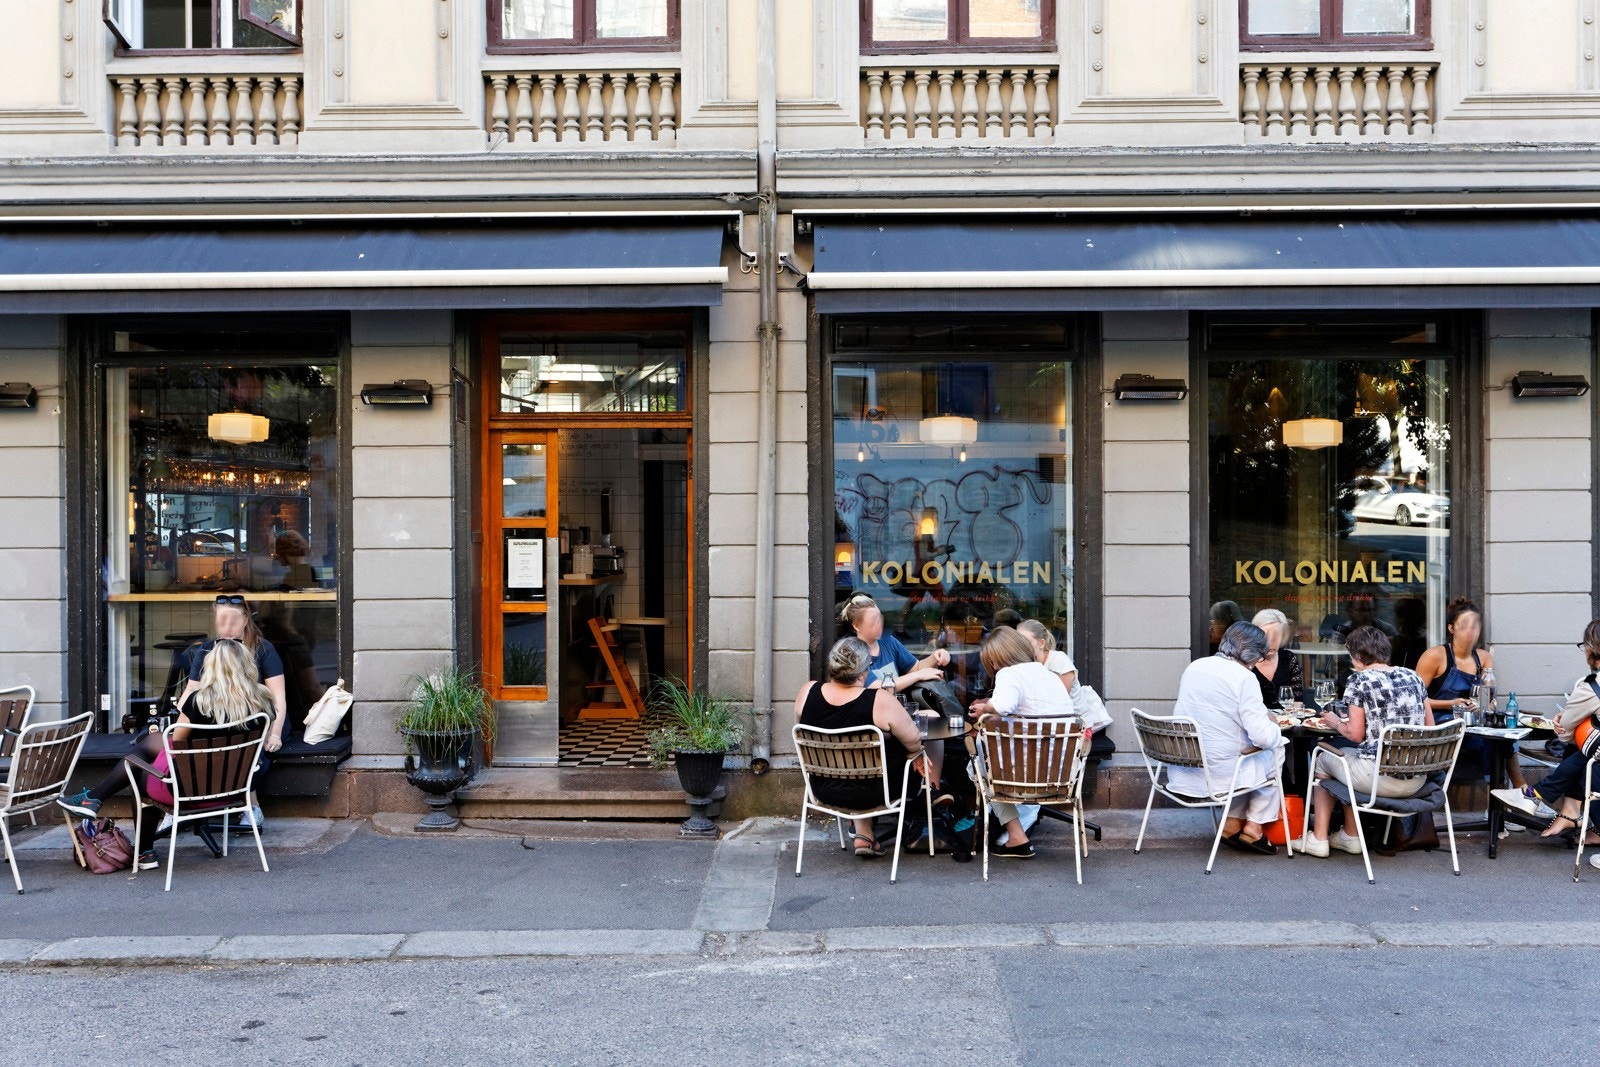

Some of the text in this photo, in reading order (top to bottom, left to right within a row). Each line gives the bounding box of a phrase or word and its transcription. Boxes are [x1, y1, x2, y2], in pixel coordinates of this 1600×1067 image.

[862, 560, 1051, 585] KOLONIALEN
[1235, 560, 1425, 585] KOLONIALEN
[1346, 592, 1374, 602] drikke
